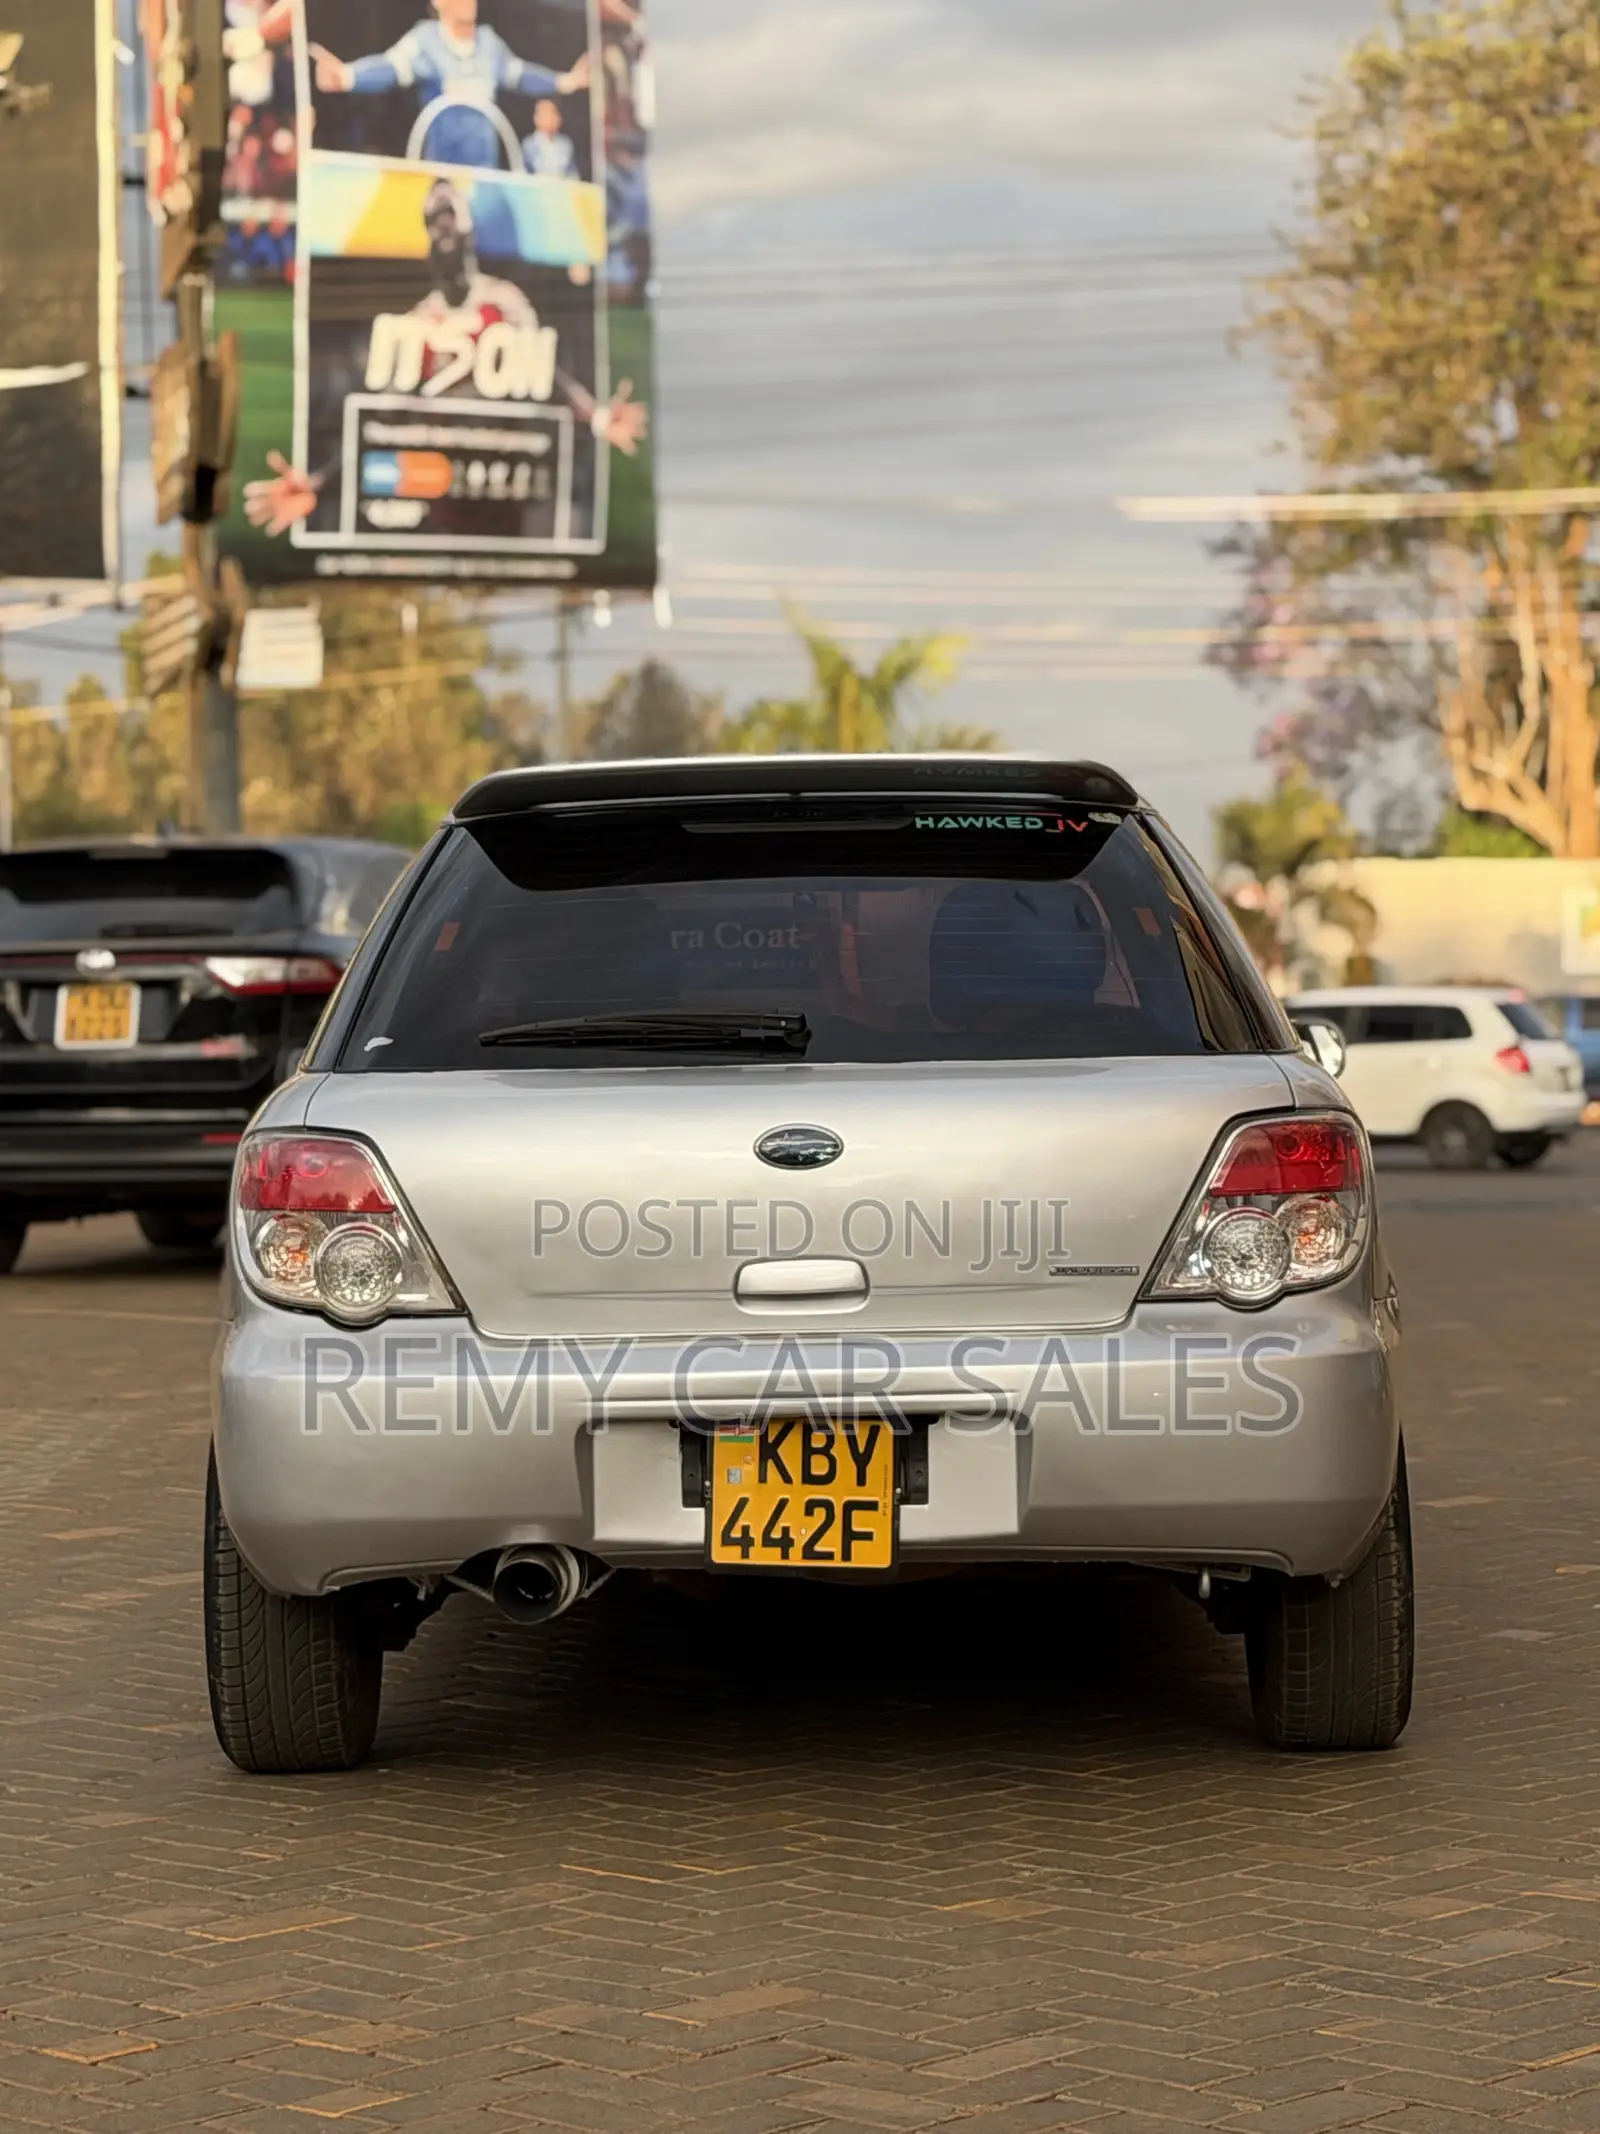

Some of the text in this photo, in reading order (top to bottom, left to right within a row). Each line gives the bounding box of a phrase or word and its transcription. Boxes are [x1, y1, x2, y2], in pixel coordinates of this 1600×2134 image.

[714, 921, 801, 950] Coat
[757, 1420, 881, 1488] KBY
[720, 1495, 880, 1563] 442F
